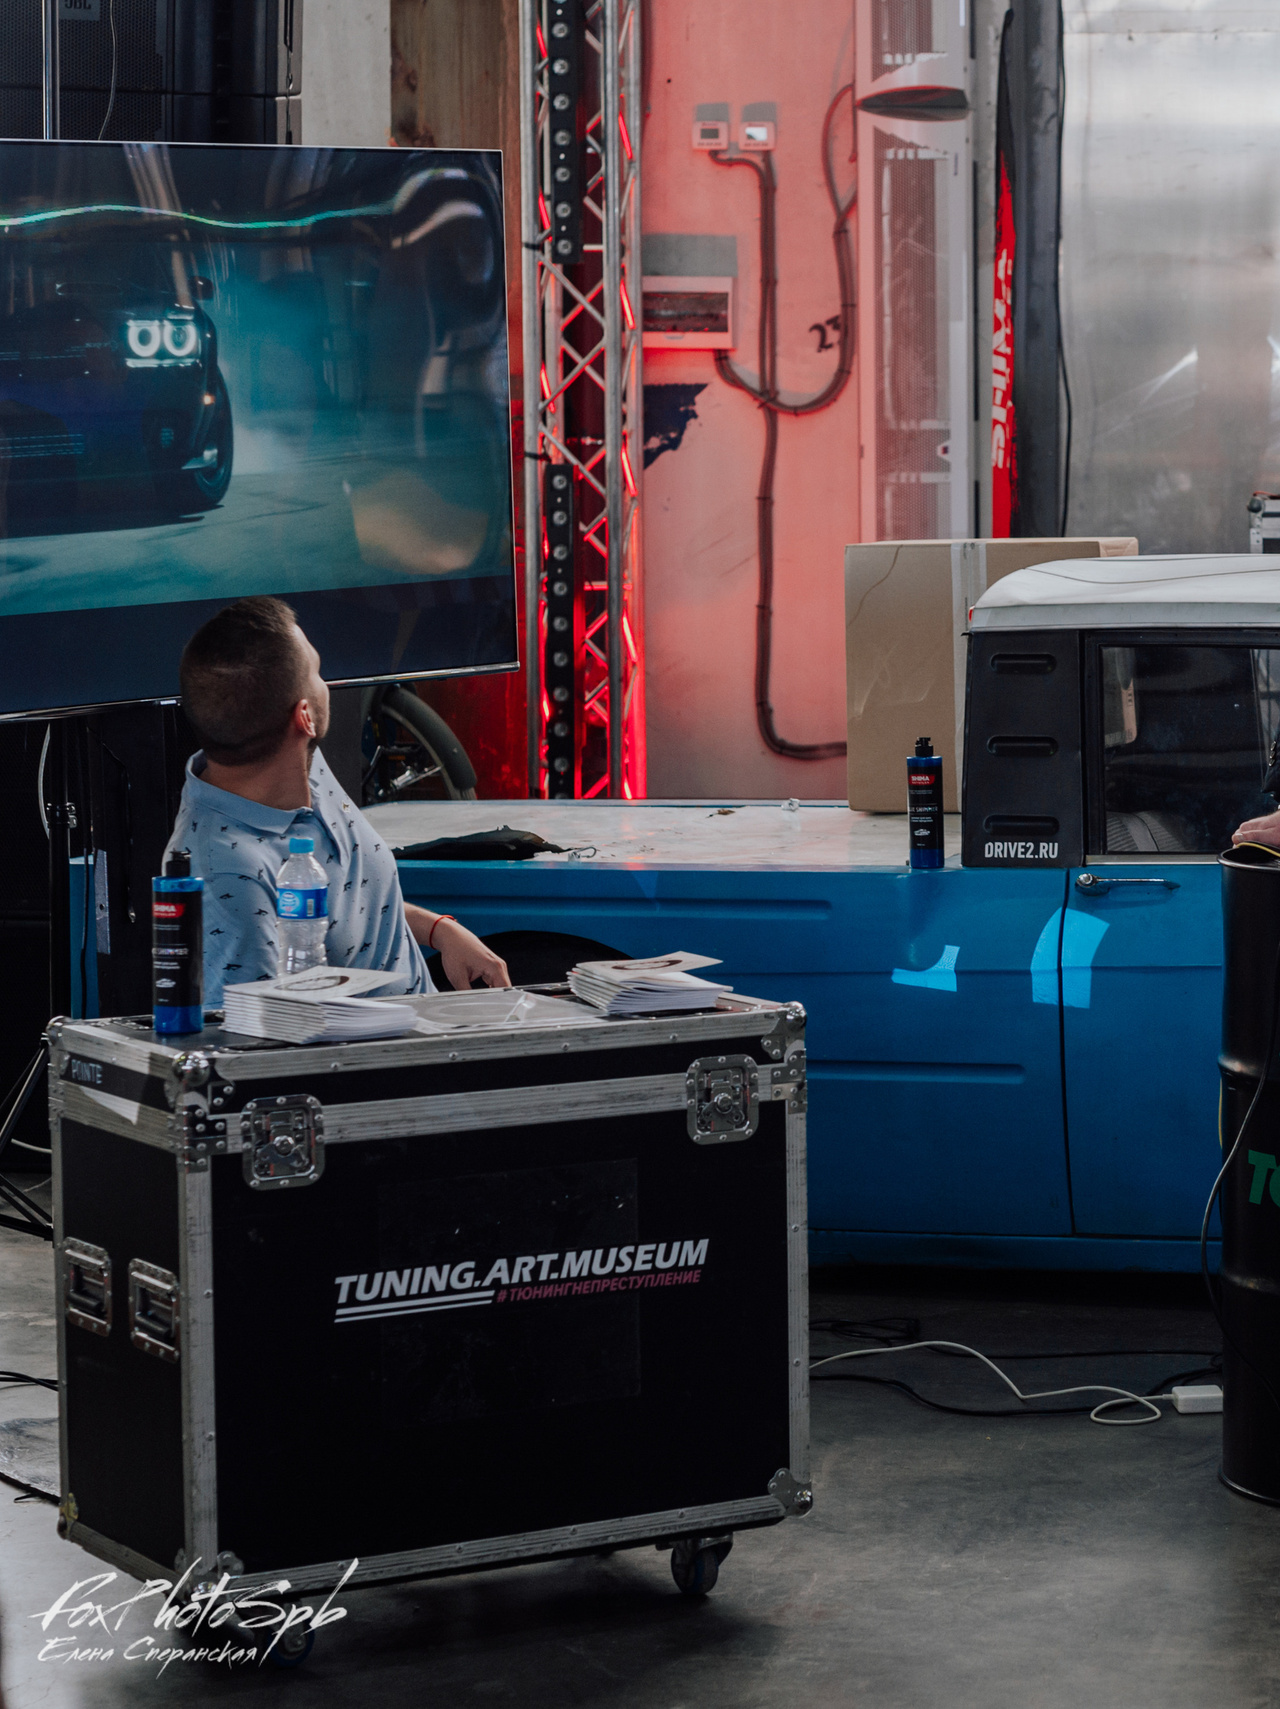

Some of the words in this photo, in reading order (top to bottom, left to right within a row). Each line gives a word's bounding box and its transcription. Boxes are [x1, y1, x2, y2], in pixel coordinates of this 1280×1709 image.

[984, 841, 1059, 859] DRIVE2.RU
[334, 1238, 709, 1304] TUNING.ART.MUSEUM
[496, 1269, 702, 1303] #ТЮНИНГНЕПРЕСТУПЛЕНИЕ
